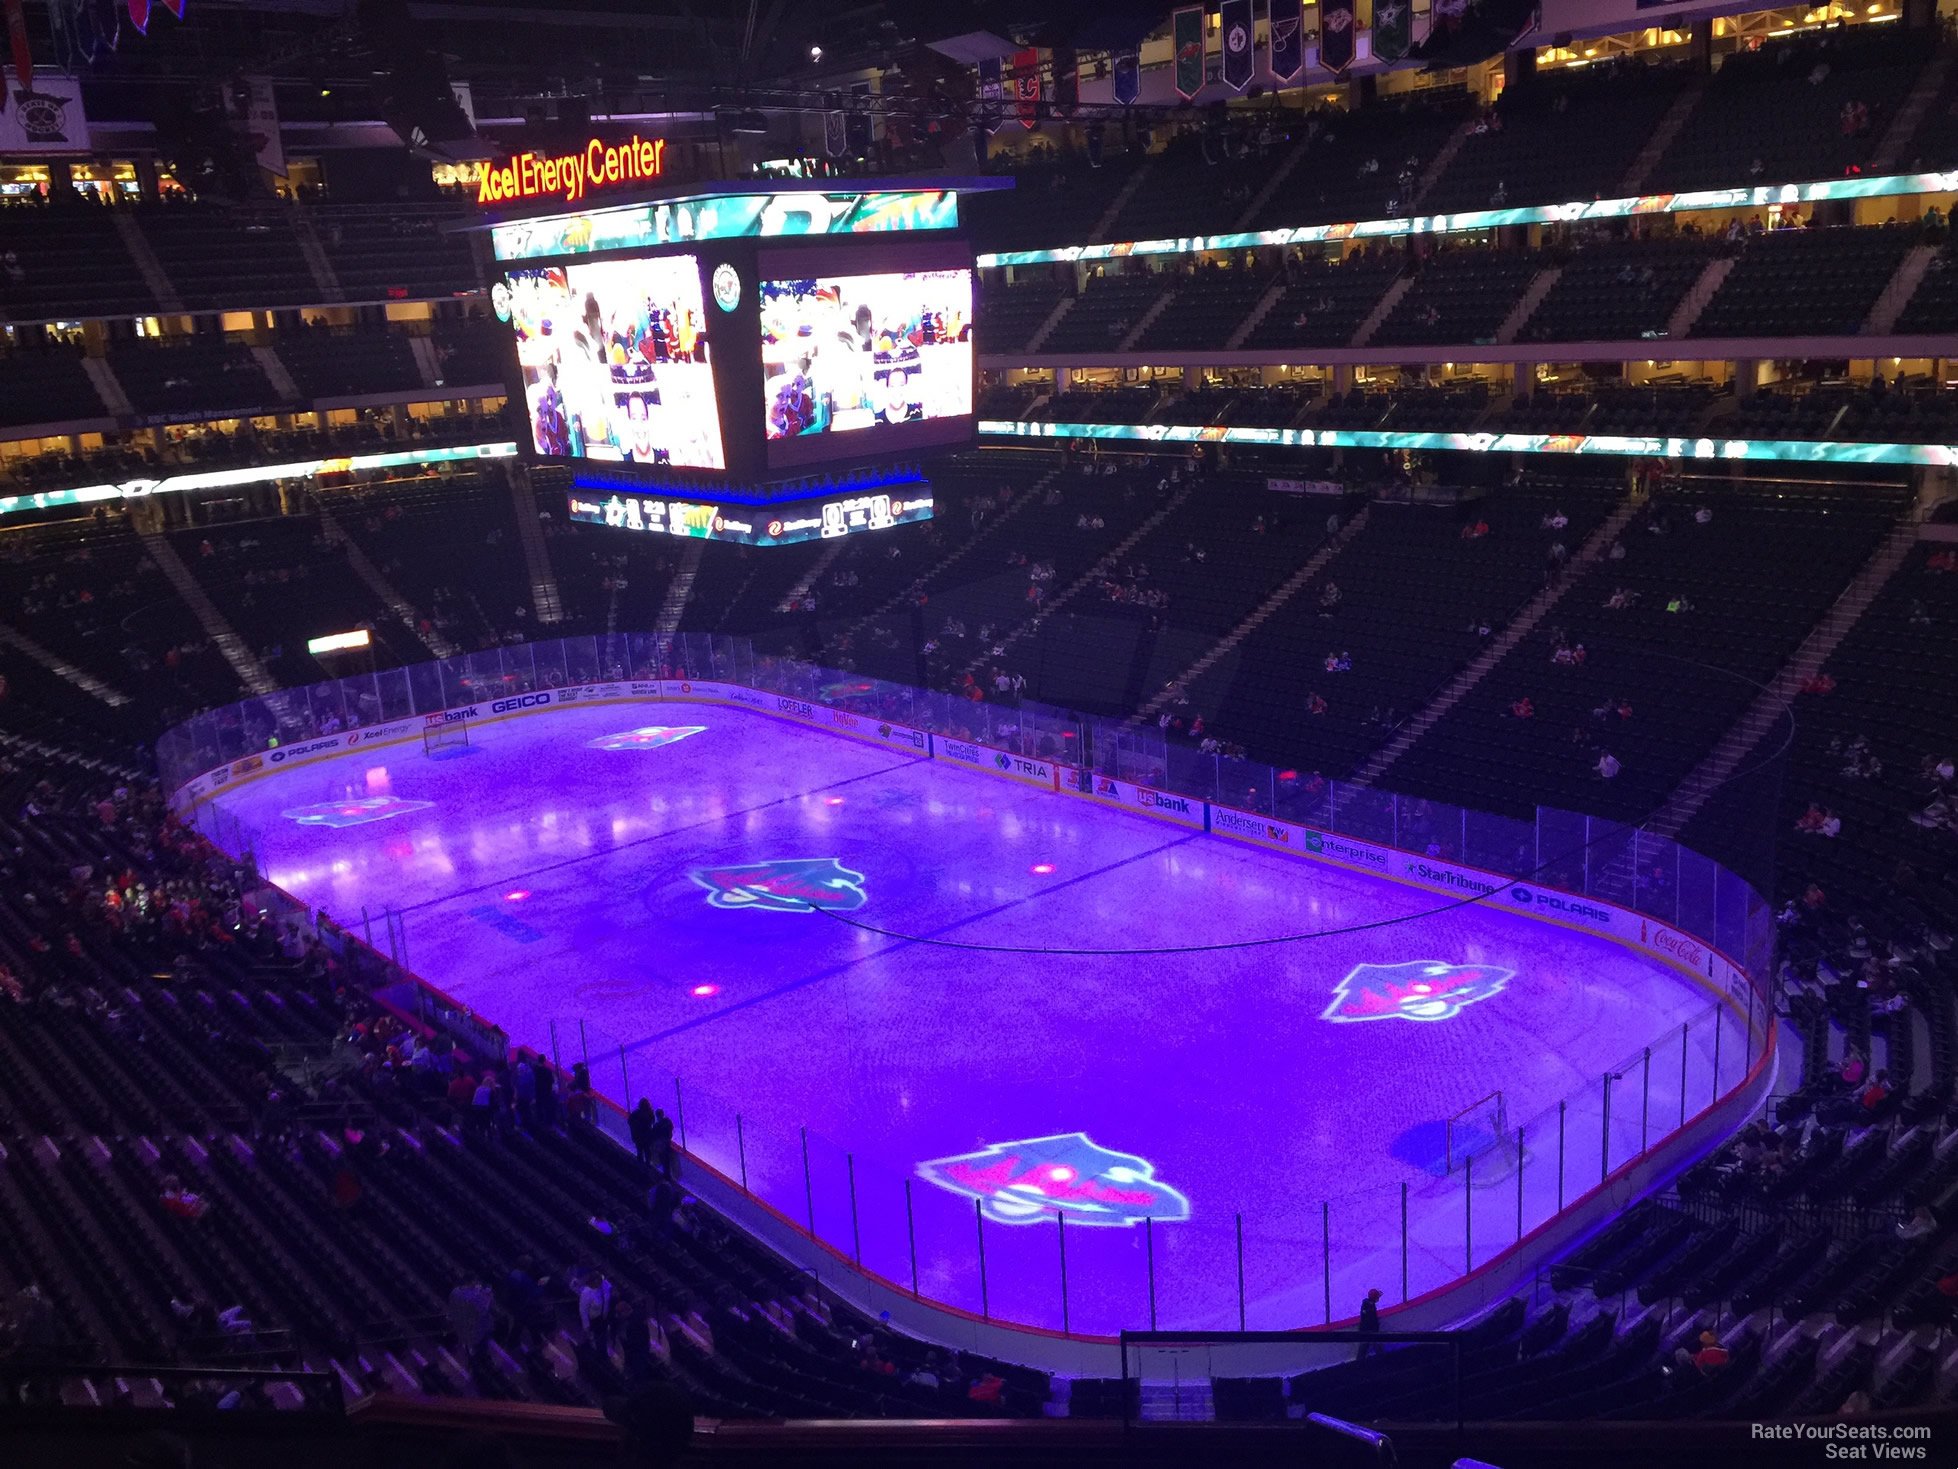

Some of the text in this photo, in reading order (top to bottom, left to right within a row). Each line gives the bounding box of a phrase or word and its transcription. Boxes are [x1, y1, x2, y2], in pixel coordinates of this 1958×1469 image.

[478, 135, 664, 203] Xcel Energy Center
[492, 693, 550, 714] GEICO
[777, 698, 814, 717] LOFFLER
[288, 739, 339, 757] POLARIS
[1014, 759, 1047, 778] TRIA
[1215, 809, 1266, 833] Andersen
[1537, 894, 1610, 923] POLARIS
